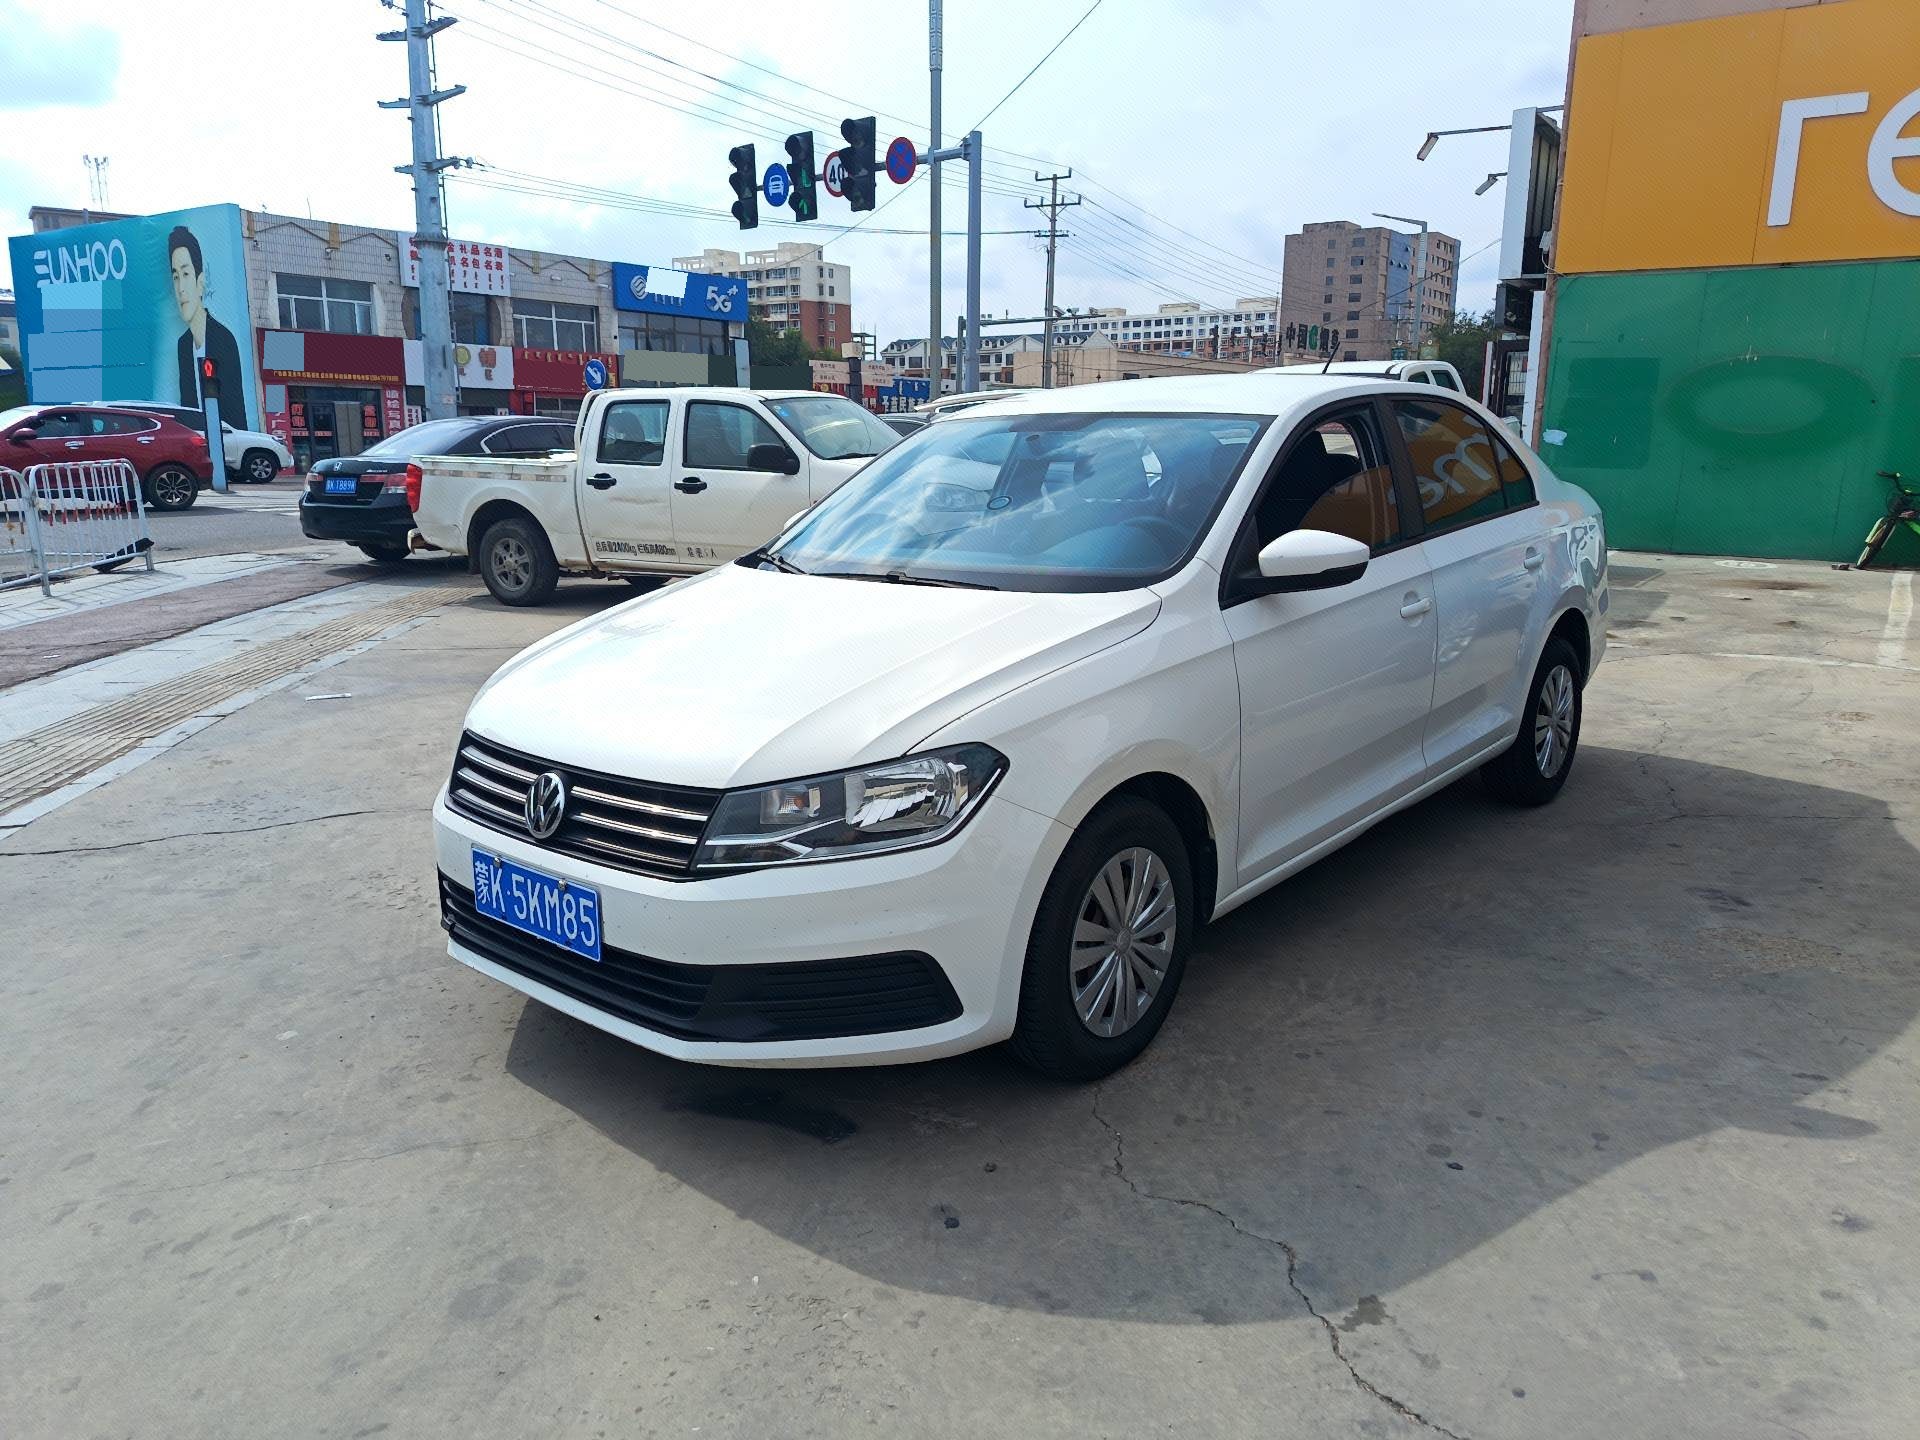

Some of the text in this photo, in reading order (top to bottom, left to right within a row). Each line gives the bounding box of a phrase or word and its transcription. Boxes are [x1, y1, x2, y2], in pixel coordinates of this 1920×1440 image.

[829, 164, 845, 185] 40
[385, 389, 401, 436] 喷绘写真
